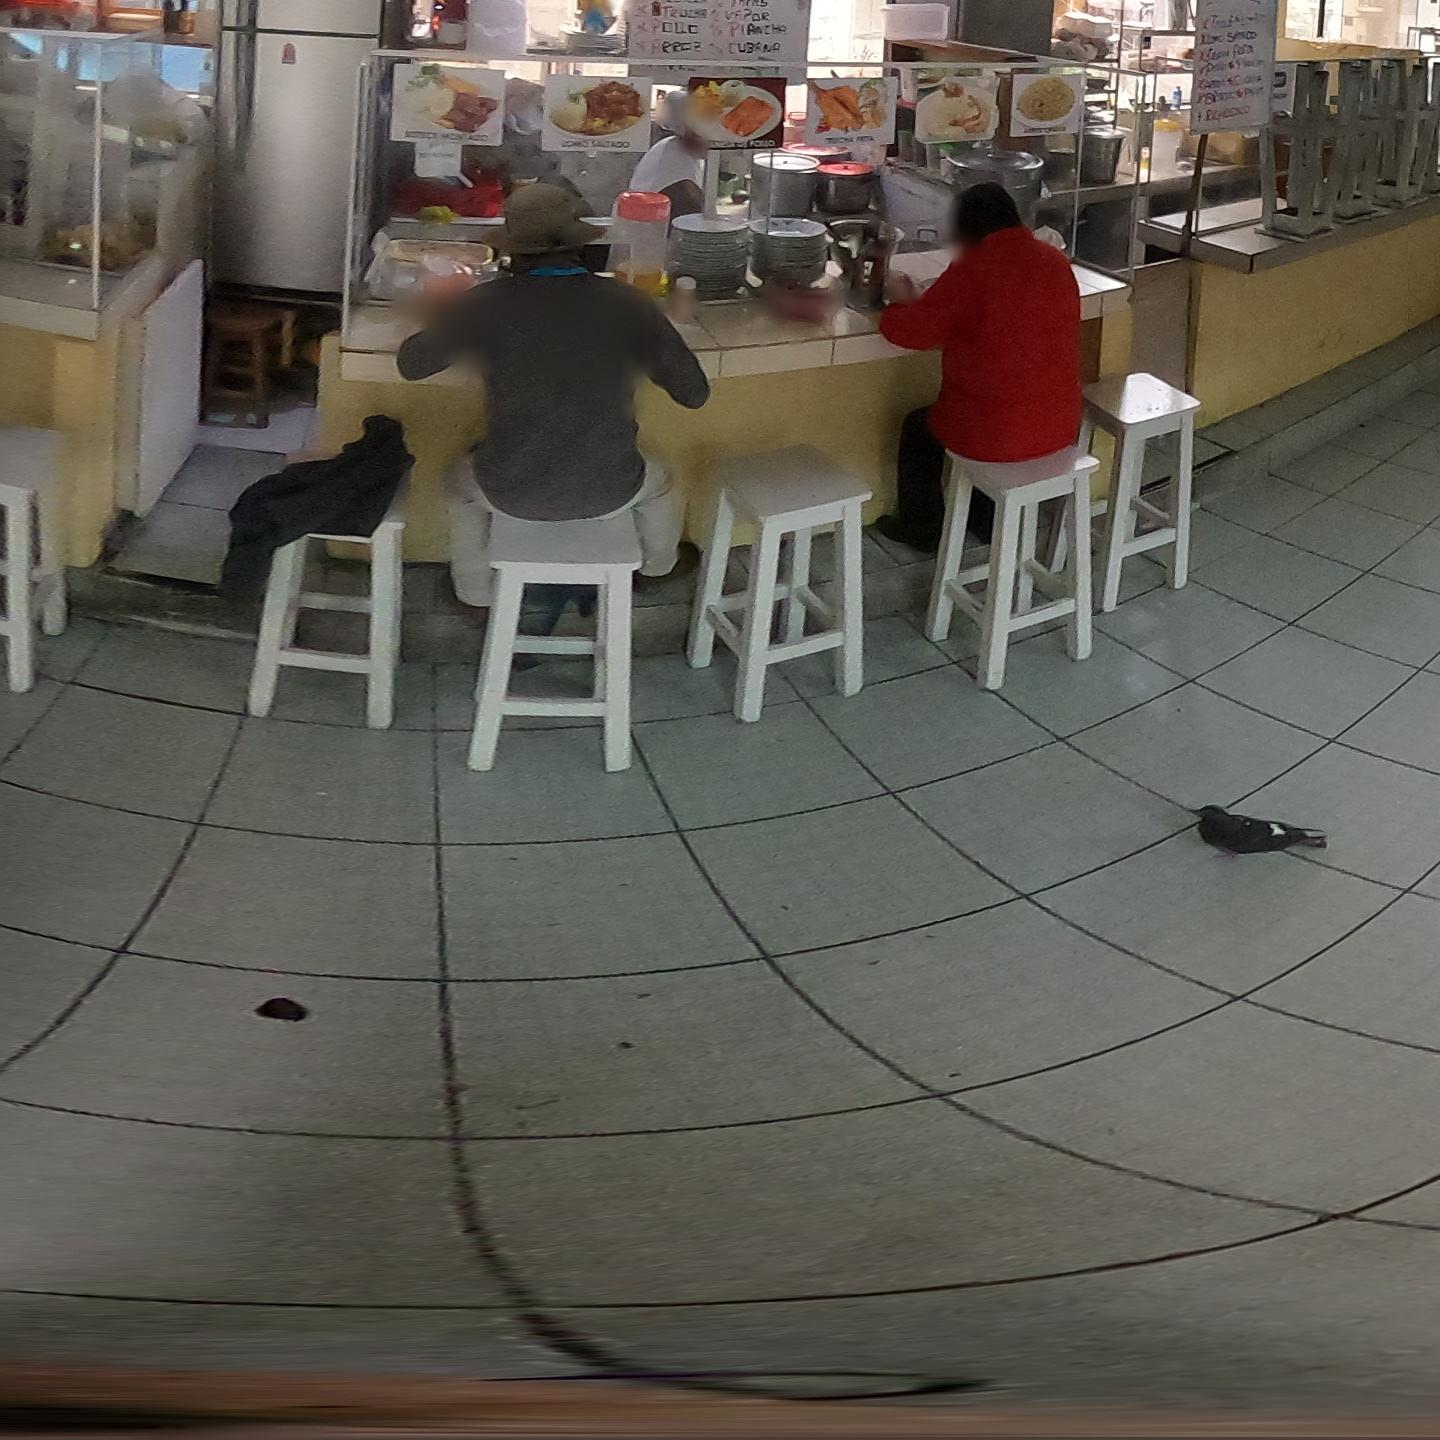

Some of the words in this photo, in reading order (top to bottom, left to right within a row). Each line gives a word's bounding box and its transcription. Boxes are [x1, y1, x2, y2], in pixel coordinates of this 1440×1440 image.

[652, 21, 700, 35] POLLO
[728, 41, 782, 55] CUBANA
[562, 140, 590, 149] LOMO
[591, 139, 631, 149] SALTADO
